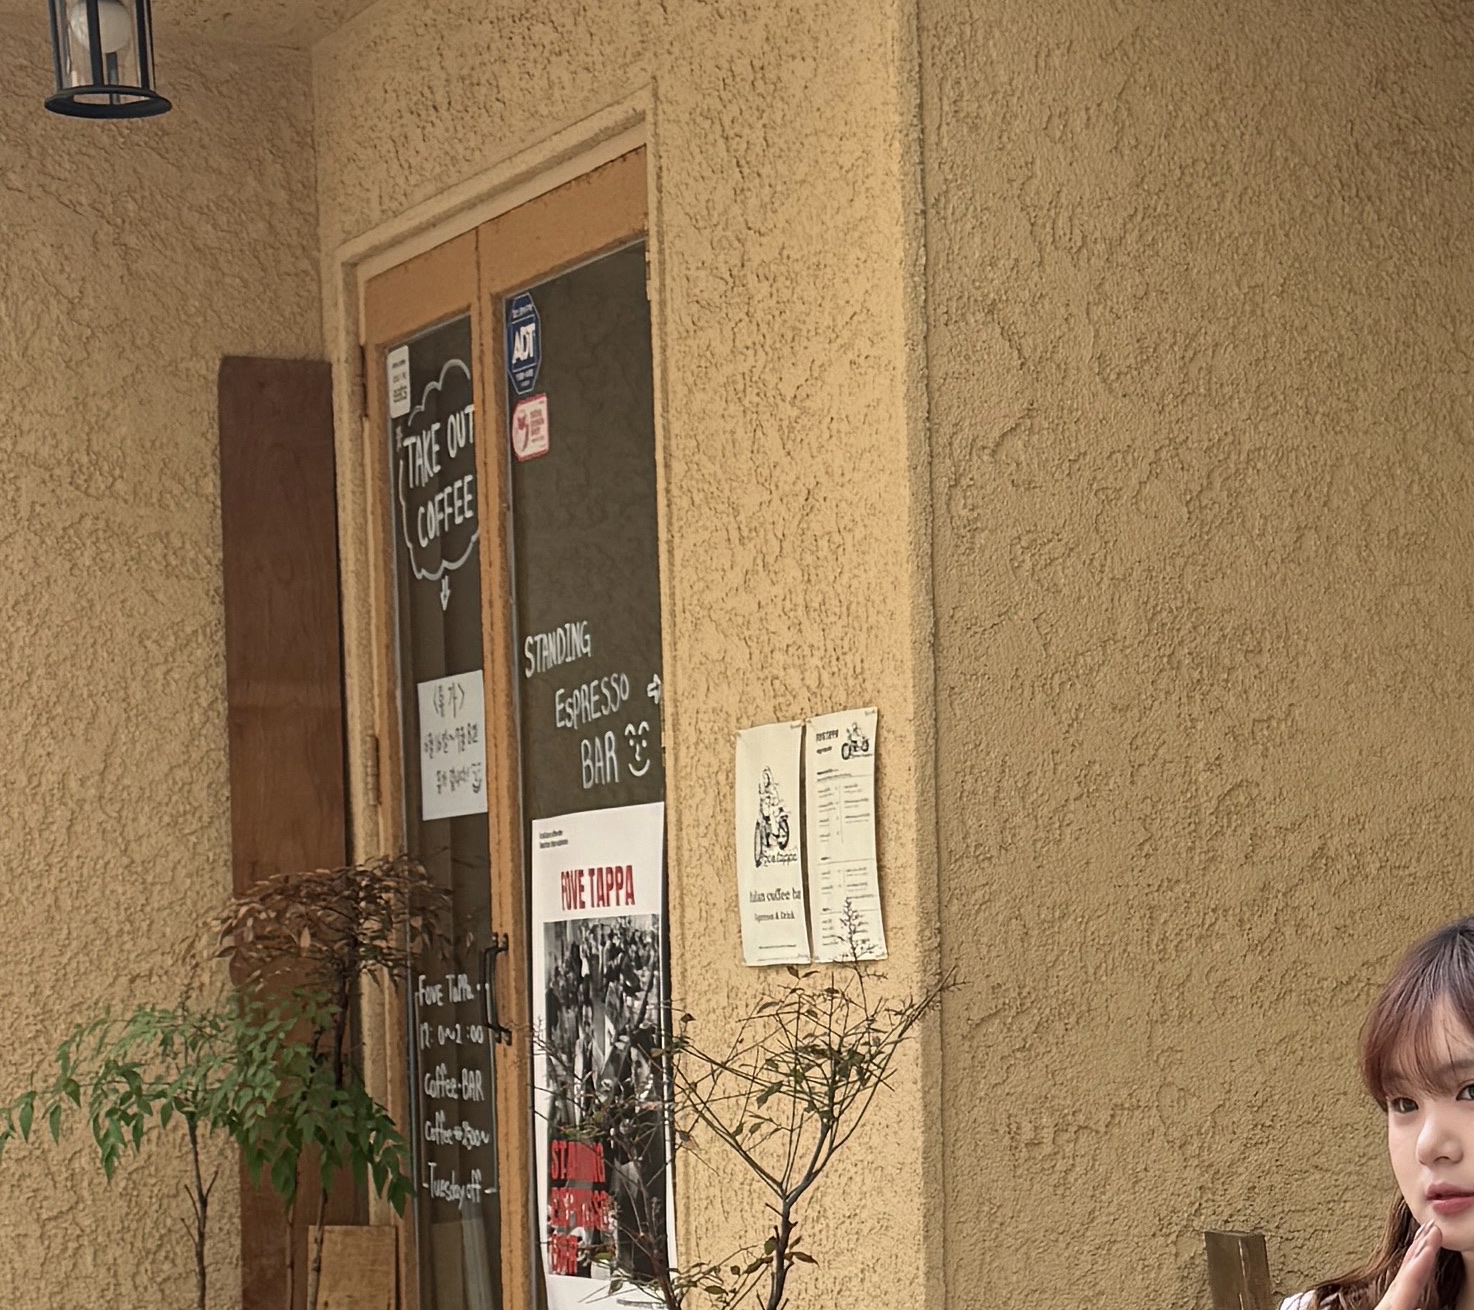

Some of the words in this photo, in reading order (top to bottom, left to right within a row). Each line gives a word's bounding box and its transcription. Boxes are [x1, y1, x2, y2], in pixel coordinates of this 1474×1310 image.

[512, 323, 536, 364] ADT
[403, 422, 441, 488] TAKE
[447, 404, 475, 459] OUT
[417, 475, 474, 548] COFFEE
[524, 620, 592, 679] STANDING
[580, 730, 620, 789] BAR
[560, 869, 586, 911] FOVE
[588, 864, 636, 908] TAPPA
[428, 1161, 464, 1210] Tuesday
[466, 1168, 482, 1203] off
